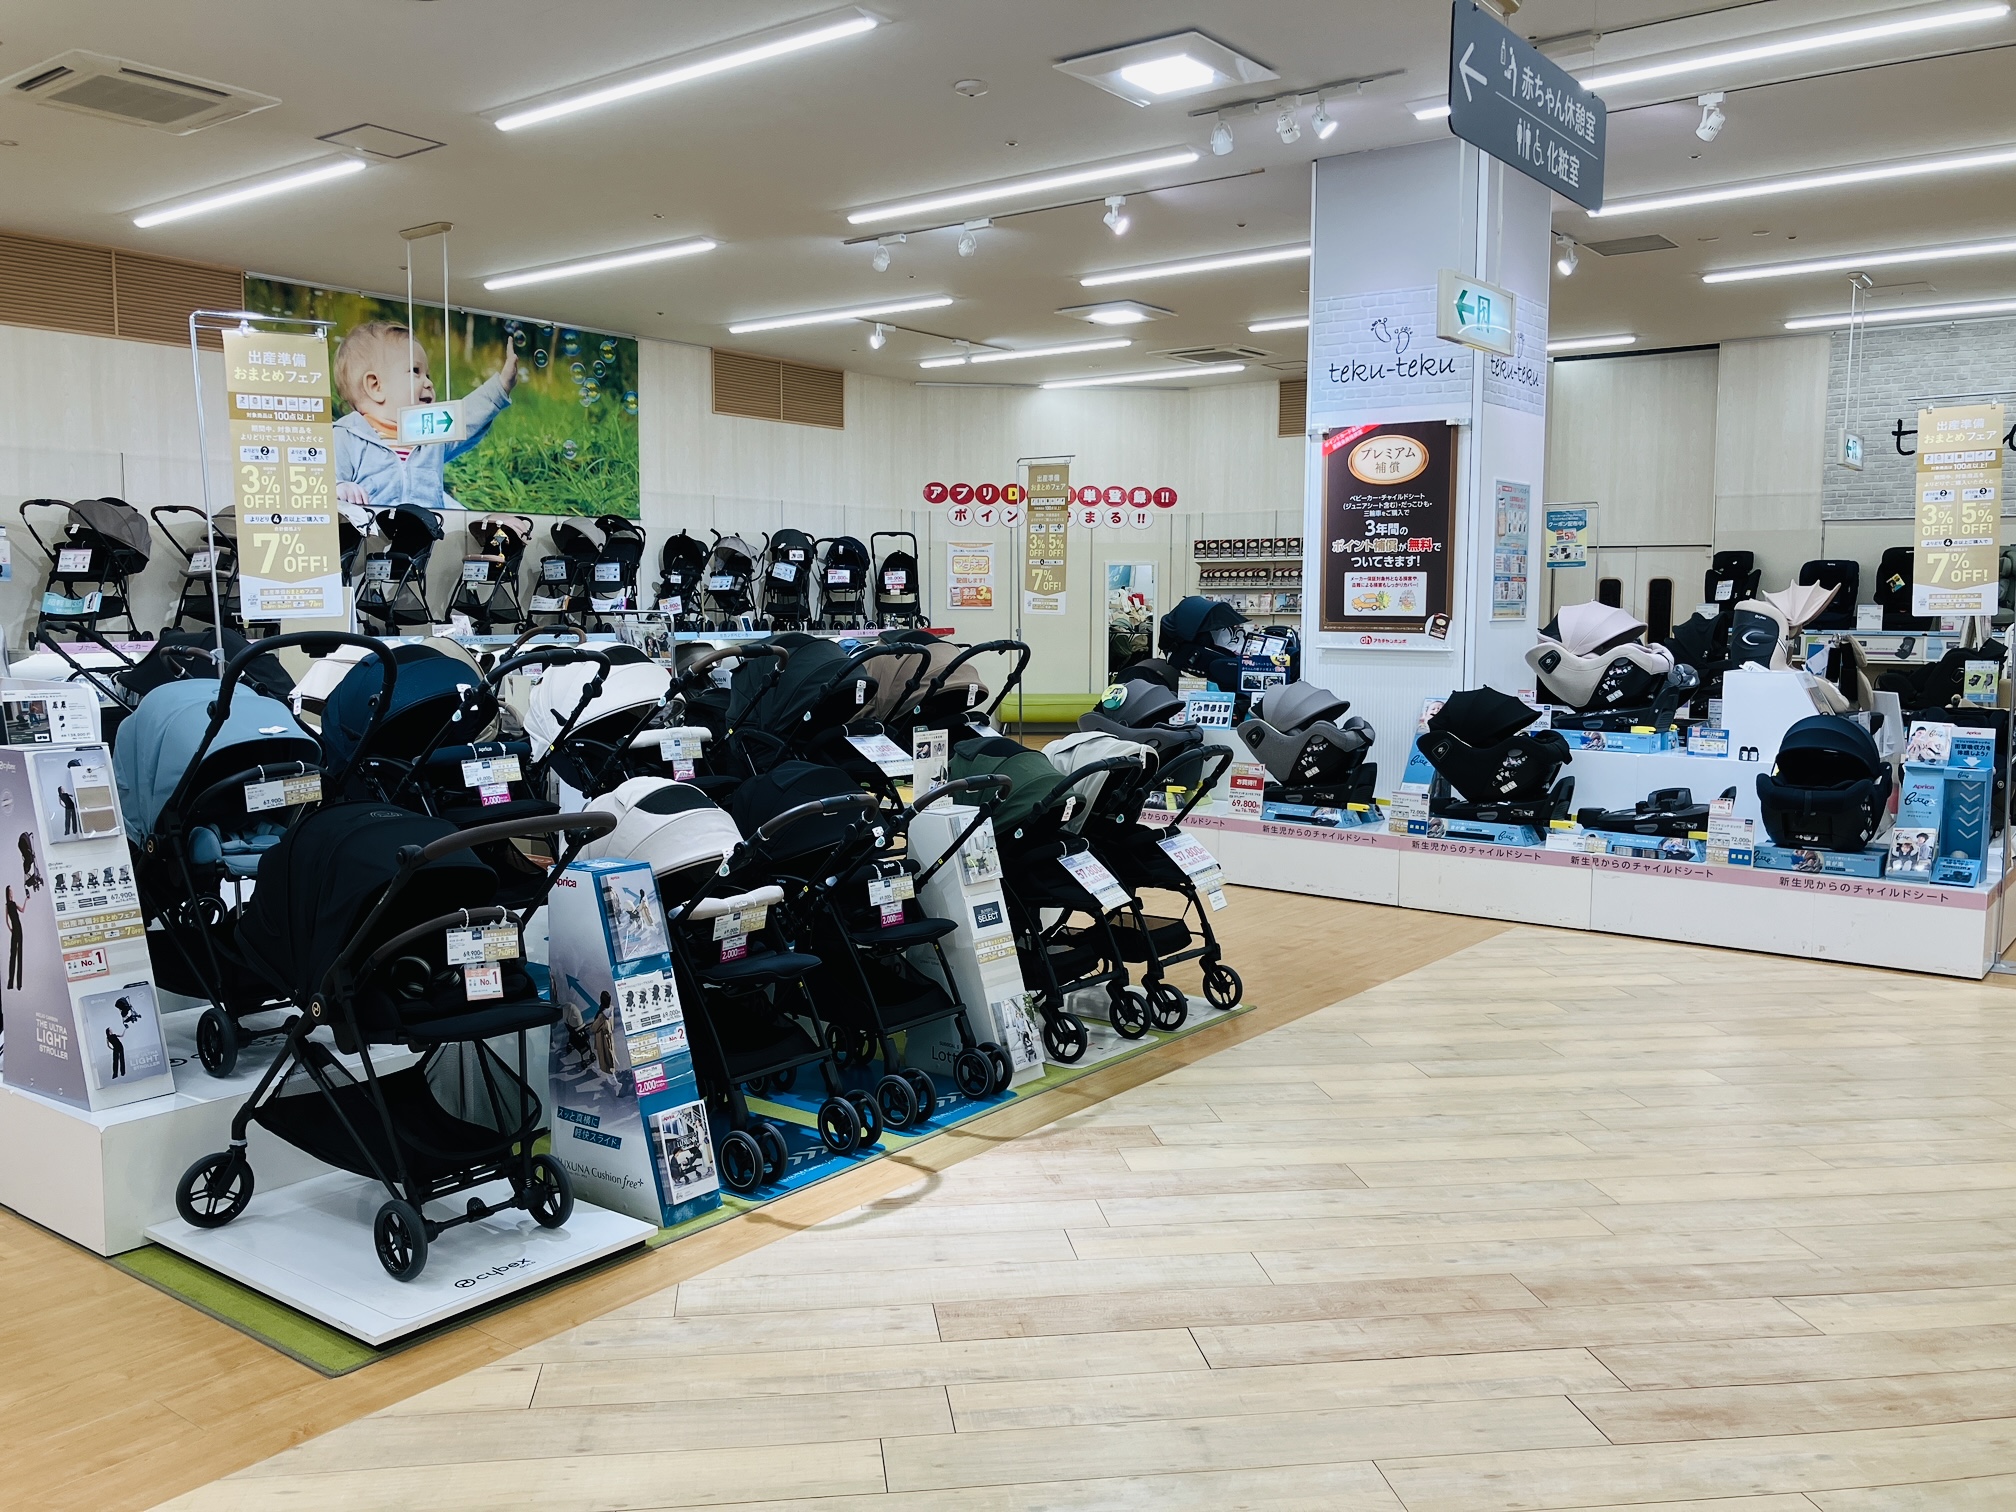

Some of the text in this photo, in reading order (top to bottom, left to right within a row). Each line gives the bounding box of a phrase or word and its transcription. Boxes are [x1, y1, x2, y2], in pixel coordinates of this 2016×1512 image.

[1522, 65, 1596, 144] 赤ちゃん休憩室
[1547, 140, 1579, 189] 化粧室
[248, 350, 307, 367] 出産準備
[234, 366, 322, 384] おまとめフェア
[1328, 353, 1456, 384] teku-teku
[1490, 354, 1540, 387] teku-teku
[1936, 418, 1985, 431] 出産準備
[1923, 430, 1997, 444] おまとめフェア
[1361, 447, 1416, 461] プレミアム
[1375, 462, 1400, 474] 補償
[241, 464, 280, 494] 3%
[289, 466, 328, 495] 5%
[243, 495, 281, 509] OFF!
[291, 495, 328, 509] OFF!
[1349, 493, 1426, 502] ベビーカー・チャイルドシート
[1921, 505, 1954, 526] 3%
[1961, 502, 1993, 524] 5%
[1365, 520, 1408, 536] 3年間の
[1922, 525, 1953, 536] OFF!
[1962, 523, 1992, 535] OFF!
[253, 533, 305, 574] 7%
[1029, 549, 1044, 557] OFF!
[1048, 549, 1063, 557] OFF!
[1332, 538, 1442, 553] ポイント補償が無料で
[284, 556, 328, 573] OFF!
[1350, 555, 1420, 568] ついてきます!
[1927, 552, 1970, 584] 7%
[1950, 569, 1988, 583] OFF!
[1043, 581, 1061, 591] OFF!
[1954, 743, 1991, 751] 衝撃吸収力を
[1231, 799, 1261, 809] 69,800円
[1262, 824, 1378, 844] 新生児からのチャイルドシート
[1411, 840, 1542, 861] 新生児からのチャイルドシート
[1570, 855, 1714, 878] 新生児からのチャイルドシート
[1778, 876, 1949, 903] 新生児からのチャイルドシート
[977, 912, 999, 924] SELECT
[36, 1018, 68, 1036] THE ULTRA
[36, 1027, 68, 1050] LIGHT
[39, 1044, 69, 1060] STROLLER
[130, 1054, 159, 1067] LIGHT
[558, 1108, 599, 1127] スッと真横に
[574, 1128, 620, 1149] 軽快スライド。
[592, 1167, 622, 1185] Cushion
[476, 1258, 531, 1280] cybex
